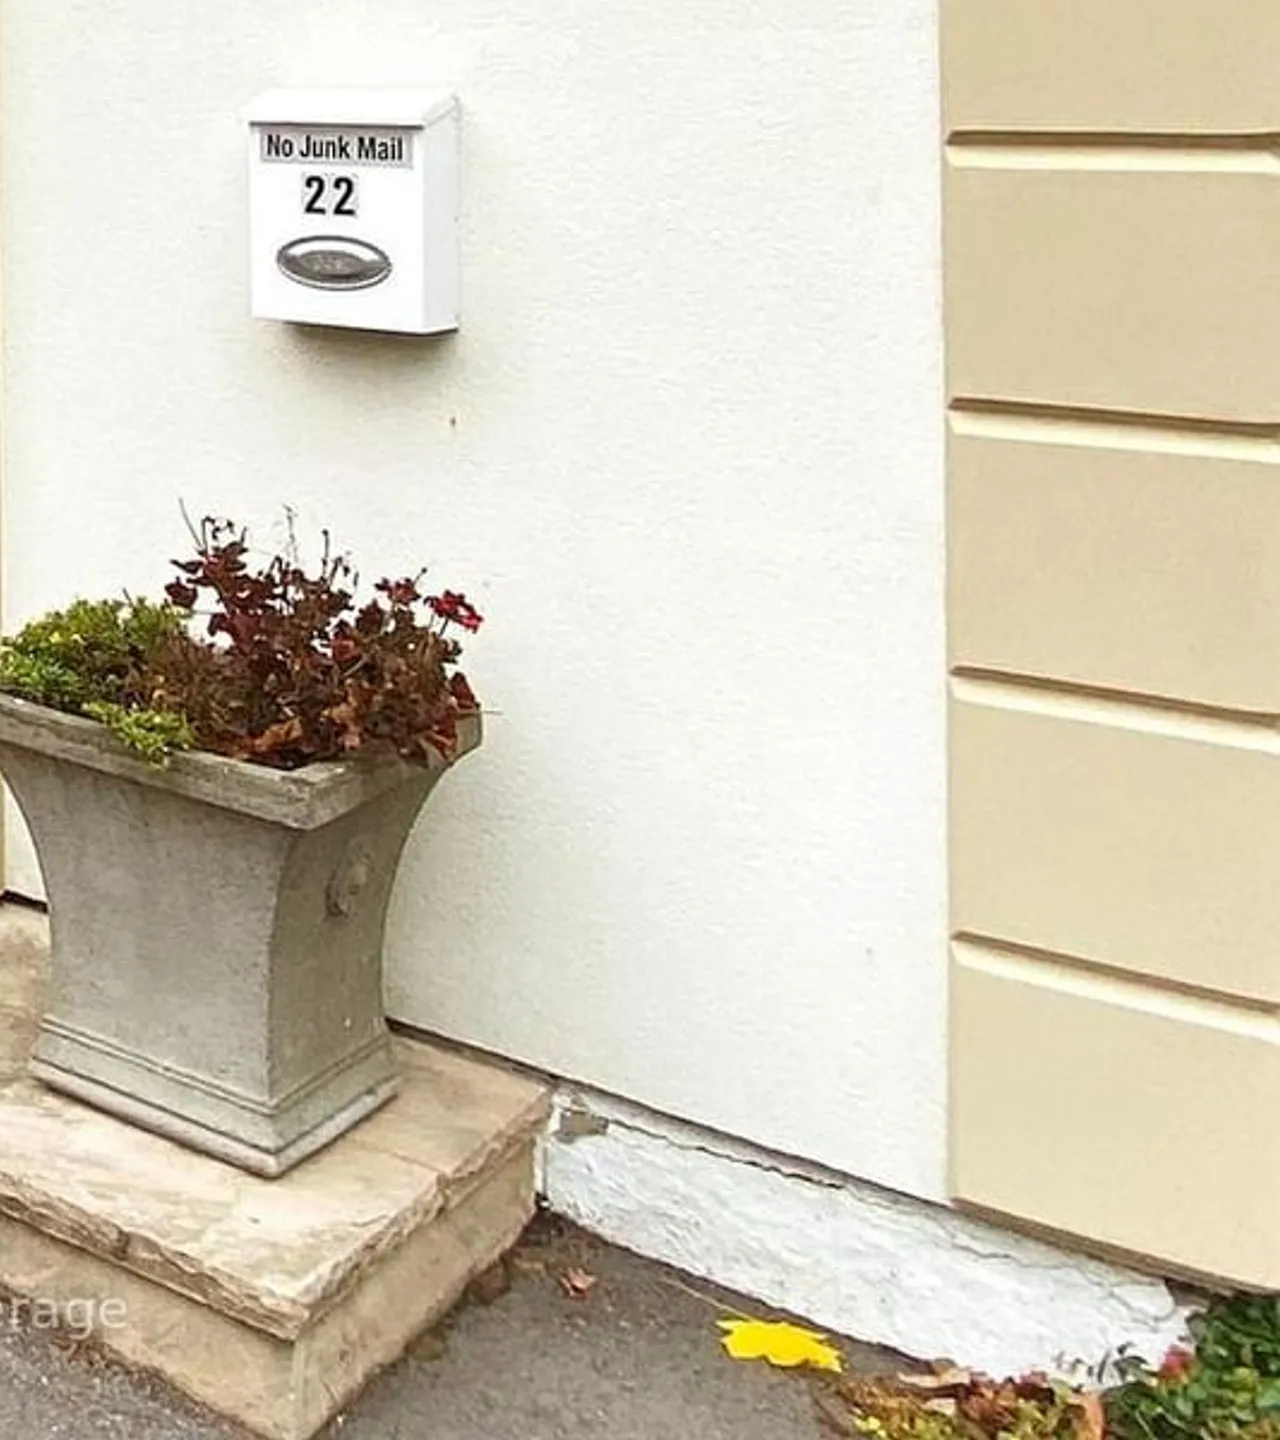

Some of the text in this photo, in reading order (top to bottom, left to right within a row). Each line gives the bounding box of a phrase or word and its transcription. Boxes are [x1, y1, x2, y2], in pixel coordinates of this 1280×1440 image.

[266, 133, 403, 161] No Junk Mail
[304, 175, 356, 216] 22
